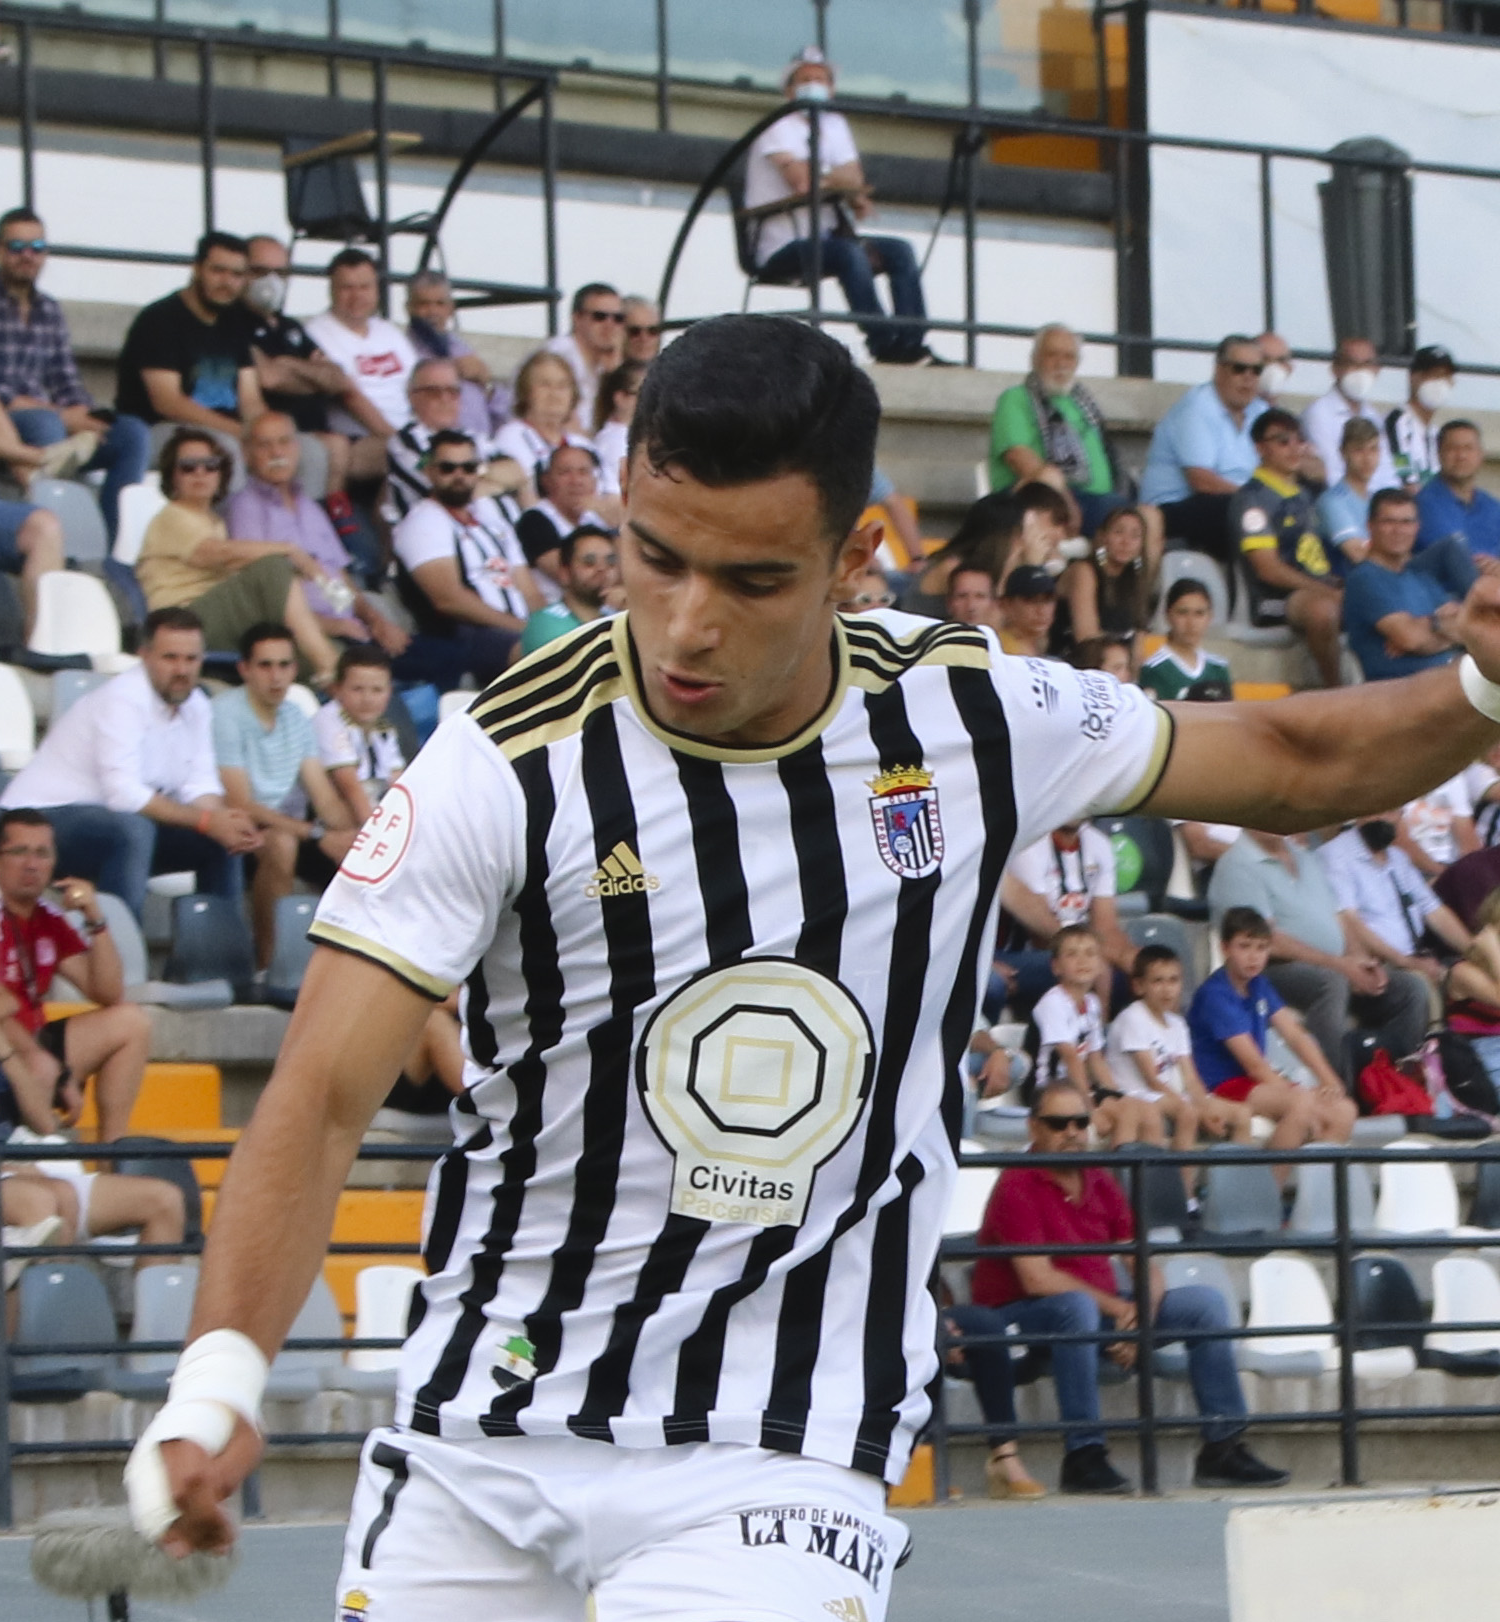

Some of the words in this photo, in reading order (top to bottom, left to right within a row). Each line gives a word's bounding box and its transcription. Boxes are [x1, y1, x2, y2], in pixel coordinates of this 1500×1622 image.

[584, 874, 660, 898] adidas
[689, 1165, 795, 1201] Civitas
[680, 1191, 794, 1225] Pacensis
[361, 1441, 409, 1570] 7
[740, 1514, 790, 1547] LA
[804, 1523, 884, 1594] MAR
